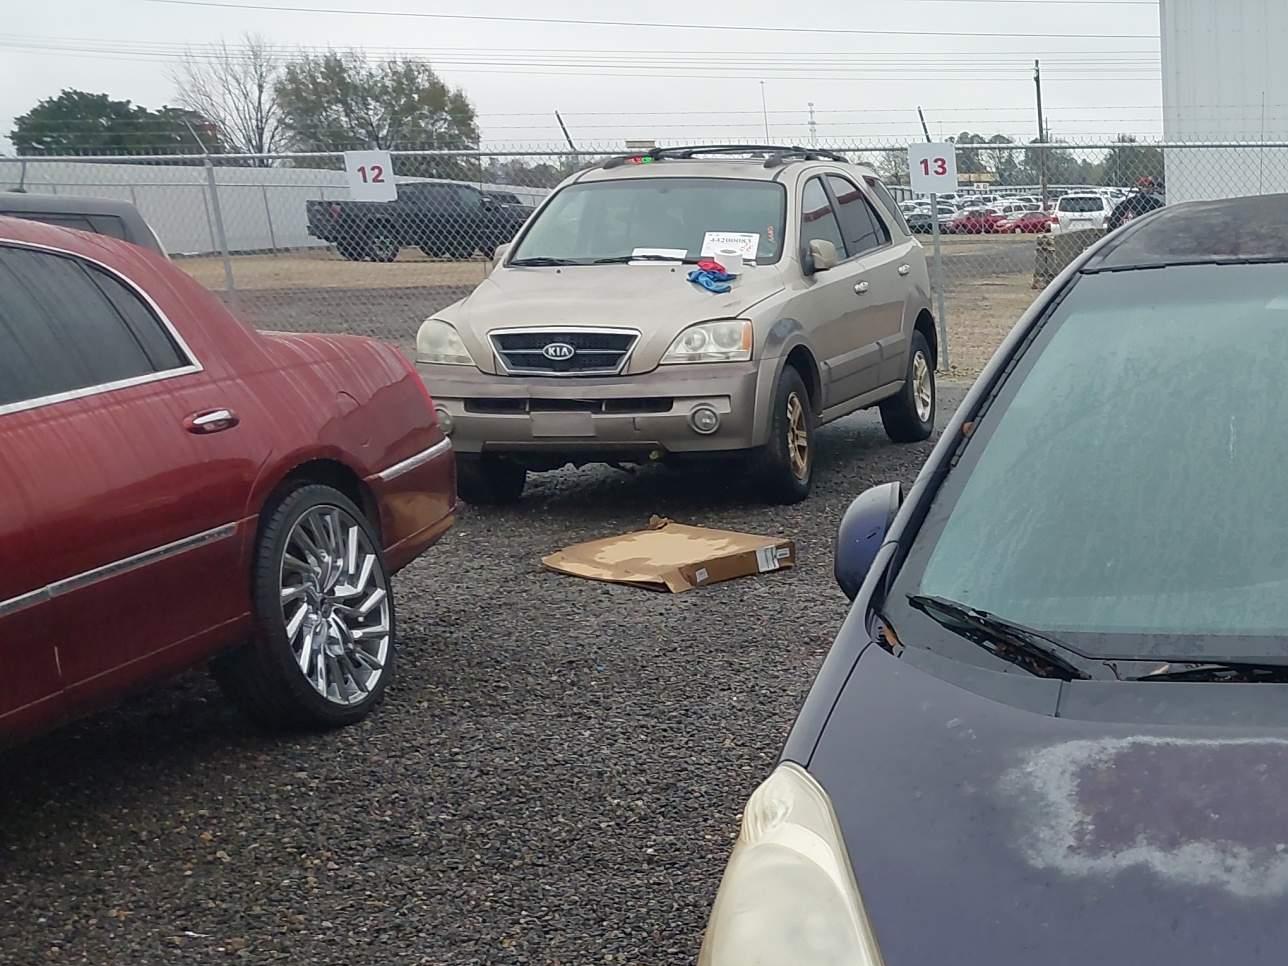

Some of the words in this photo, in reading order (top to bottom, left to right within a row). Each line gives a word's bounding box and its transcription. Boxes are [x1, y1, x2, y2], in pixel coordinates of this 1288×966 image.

[357, 165, 385, 183] 12
[919, 157, 947, 176] 13
[547, 347, 570, 356] KIA
